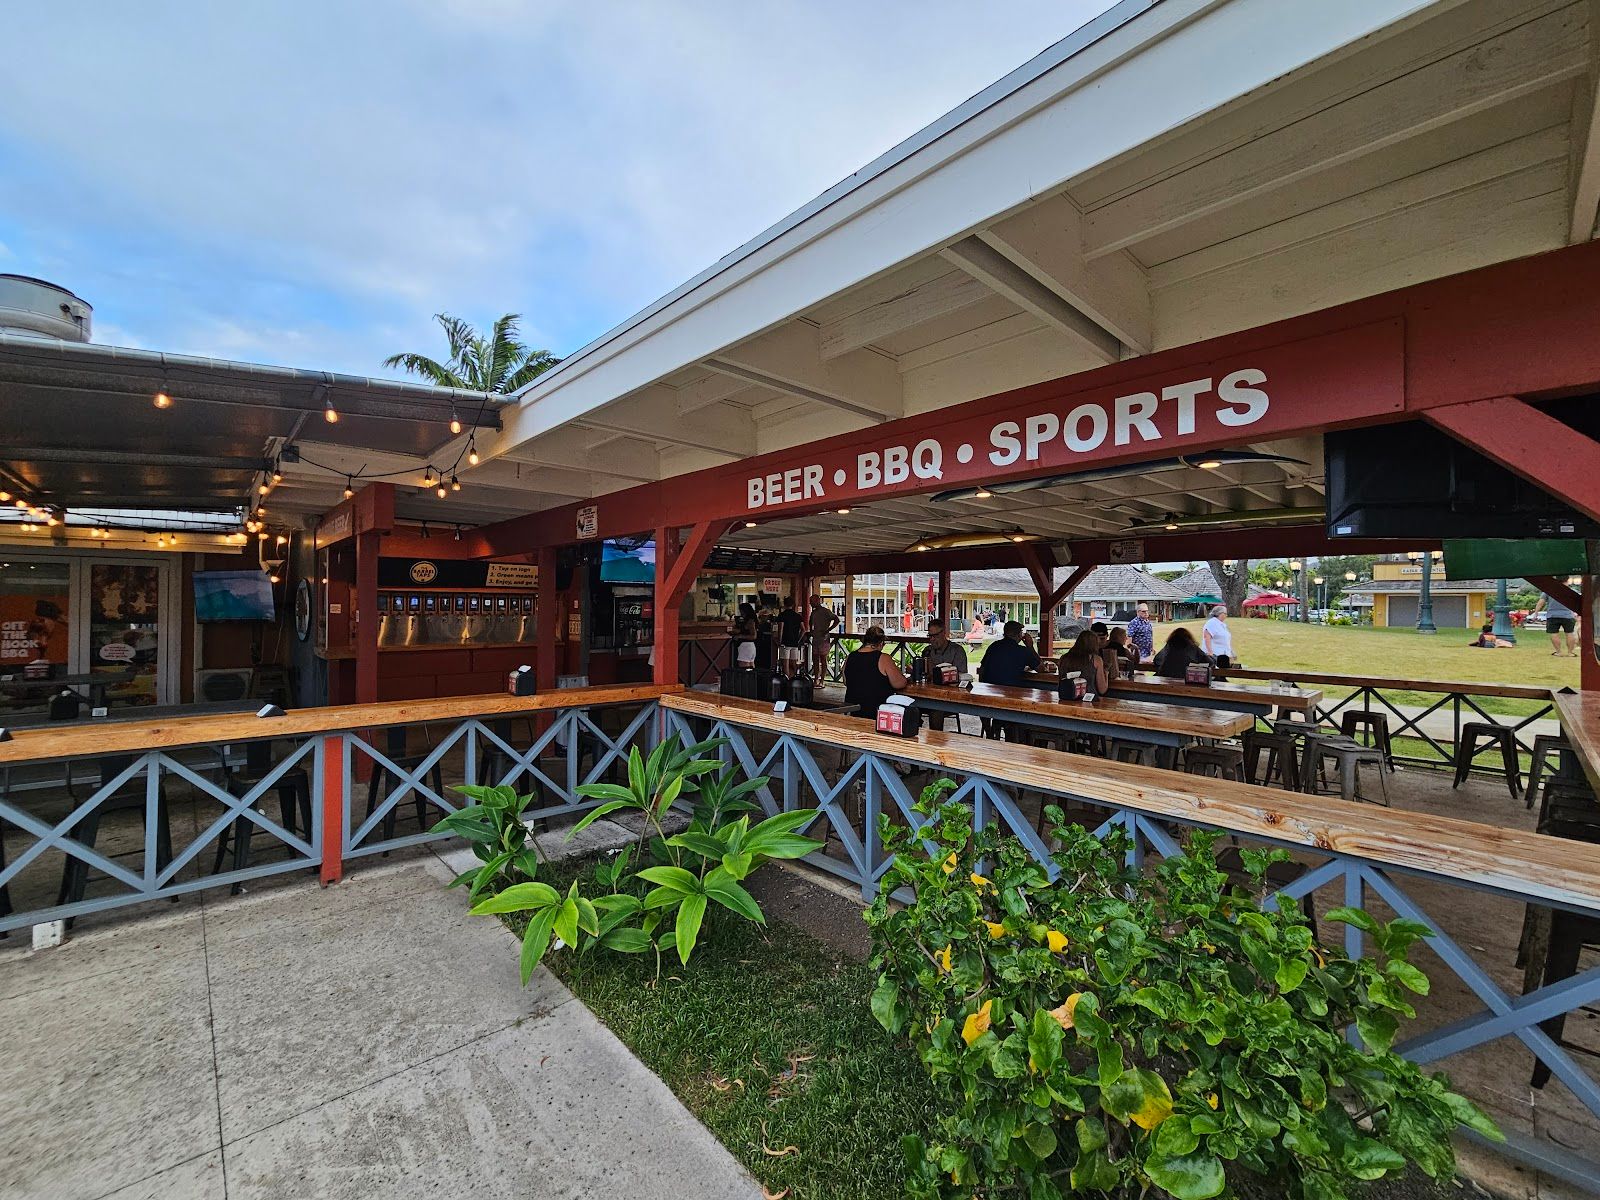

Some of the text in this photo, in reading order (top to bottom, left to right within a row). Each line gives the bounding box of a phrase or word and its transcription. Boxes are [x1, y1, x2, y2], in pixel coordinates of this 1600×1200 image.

[747, 367, 1270, 510] BEER BBQ SPORTS
[1, 621, 26, 631] OFF
[1, 631, 28, 639] THE
[1, 640, 40, 649] HOOK
[1, 649, 28, 658] BBQ
